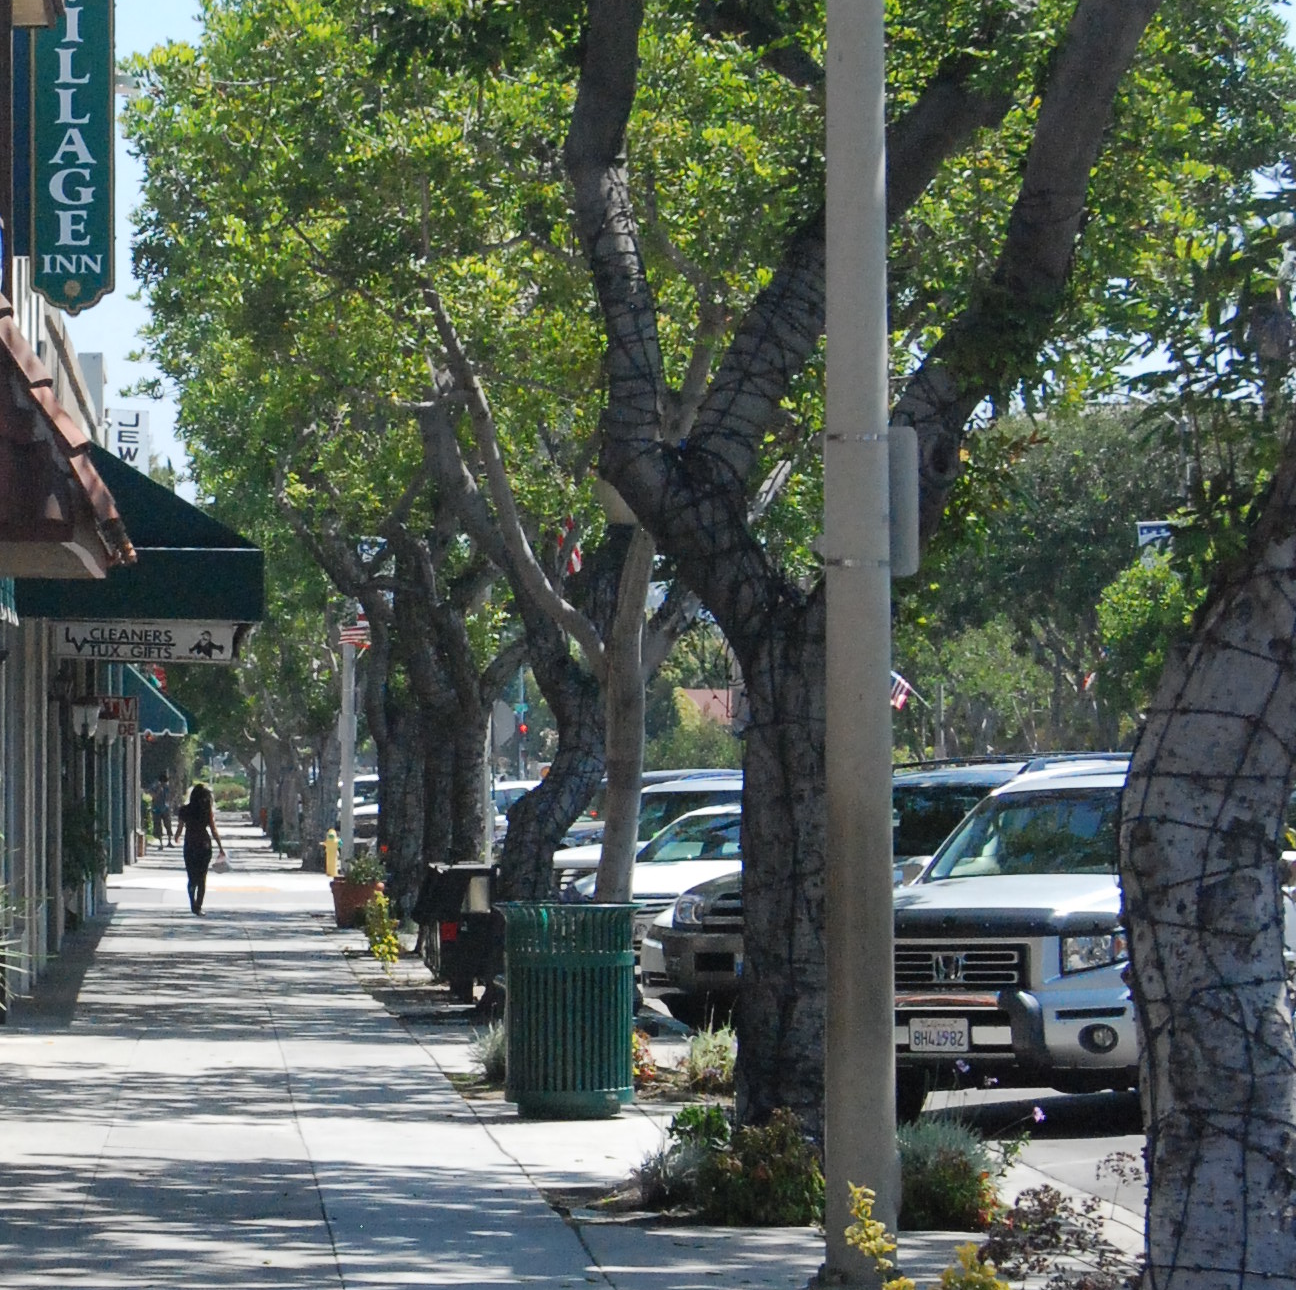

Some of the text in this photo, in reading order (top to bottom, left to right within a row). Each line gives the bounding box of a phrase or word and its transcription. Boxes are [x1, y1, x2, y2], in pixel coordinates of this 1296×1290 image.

[41, 254, 104, 275] INN
[117, 412, 140, 469] JEW
[89, 627, 173, 644] CLEANERS
[130, 645, 173, 659] GIFTS
